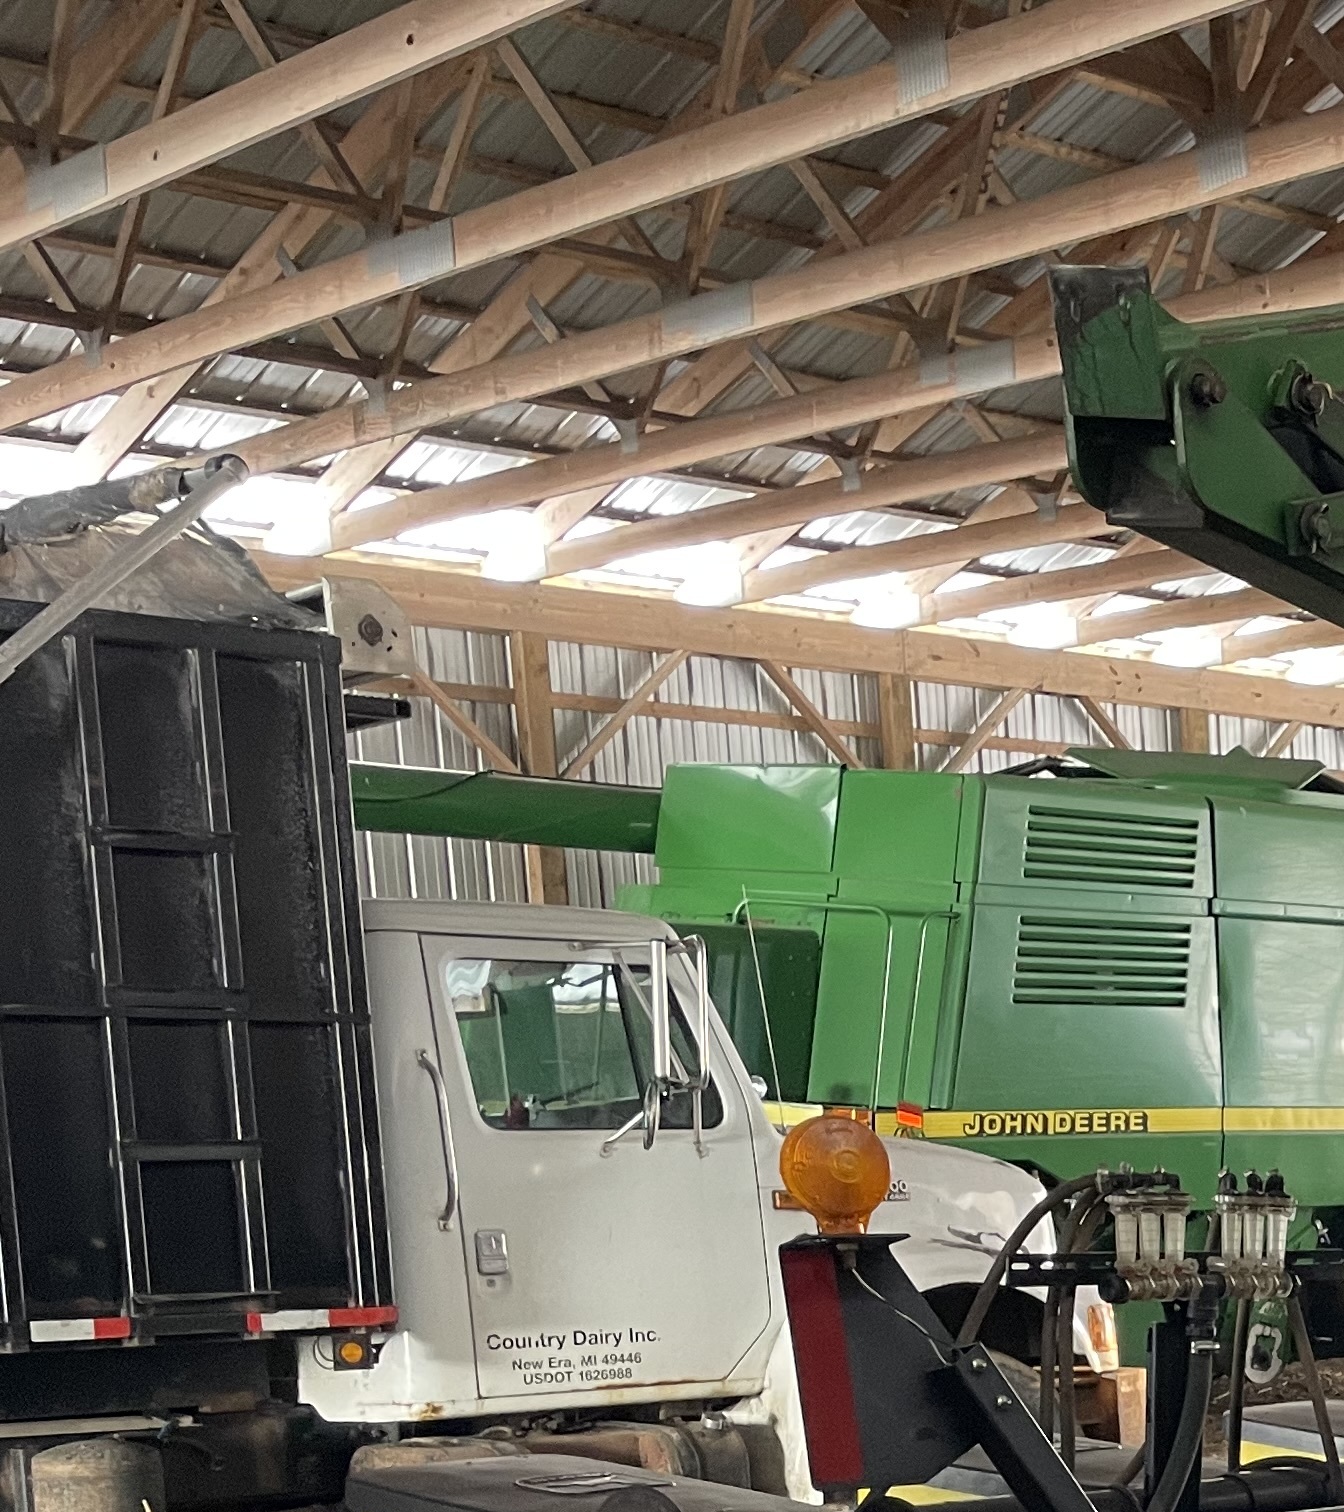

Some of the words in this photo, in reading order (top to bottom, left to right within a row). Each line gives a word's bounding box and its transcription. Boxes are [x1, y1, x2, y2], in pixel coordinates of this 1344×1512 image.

[963, 1112, 1048, 1136] JOHN
[1053, 1111, 1148, 1133] DEERE
[486, 1332, 566, 1351] Country
[573, 1329, 623, 1347] Dairy
[629, 1327, 662, 1343] Inc.
[512, 1358, 543, 1371] New
[548, 1356, 576, 1369] Era,
[580, 1354, 597, 1367] MI
[601, 1352, 642, 1366] 49446
[523, 1370, 574, 1386] USDOT
